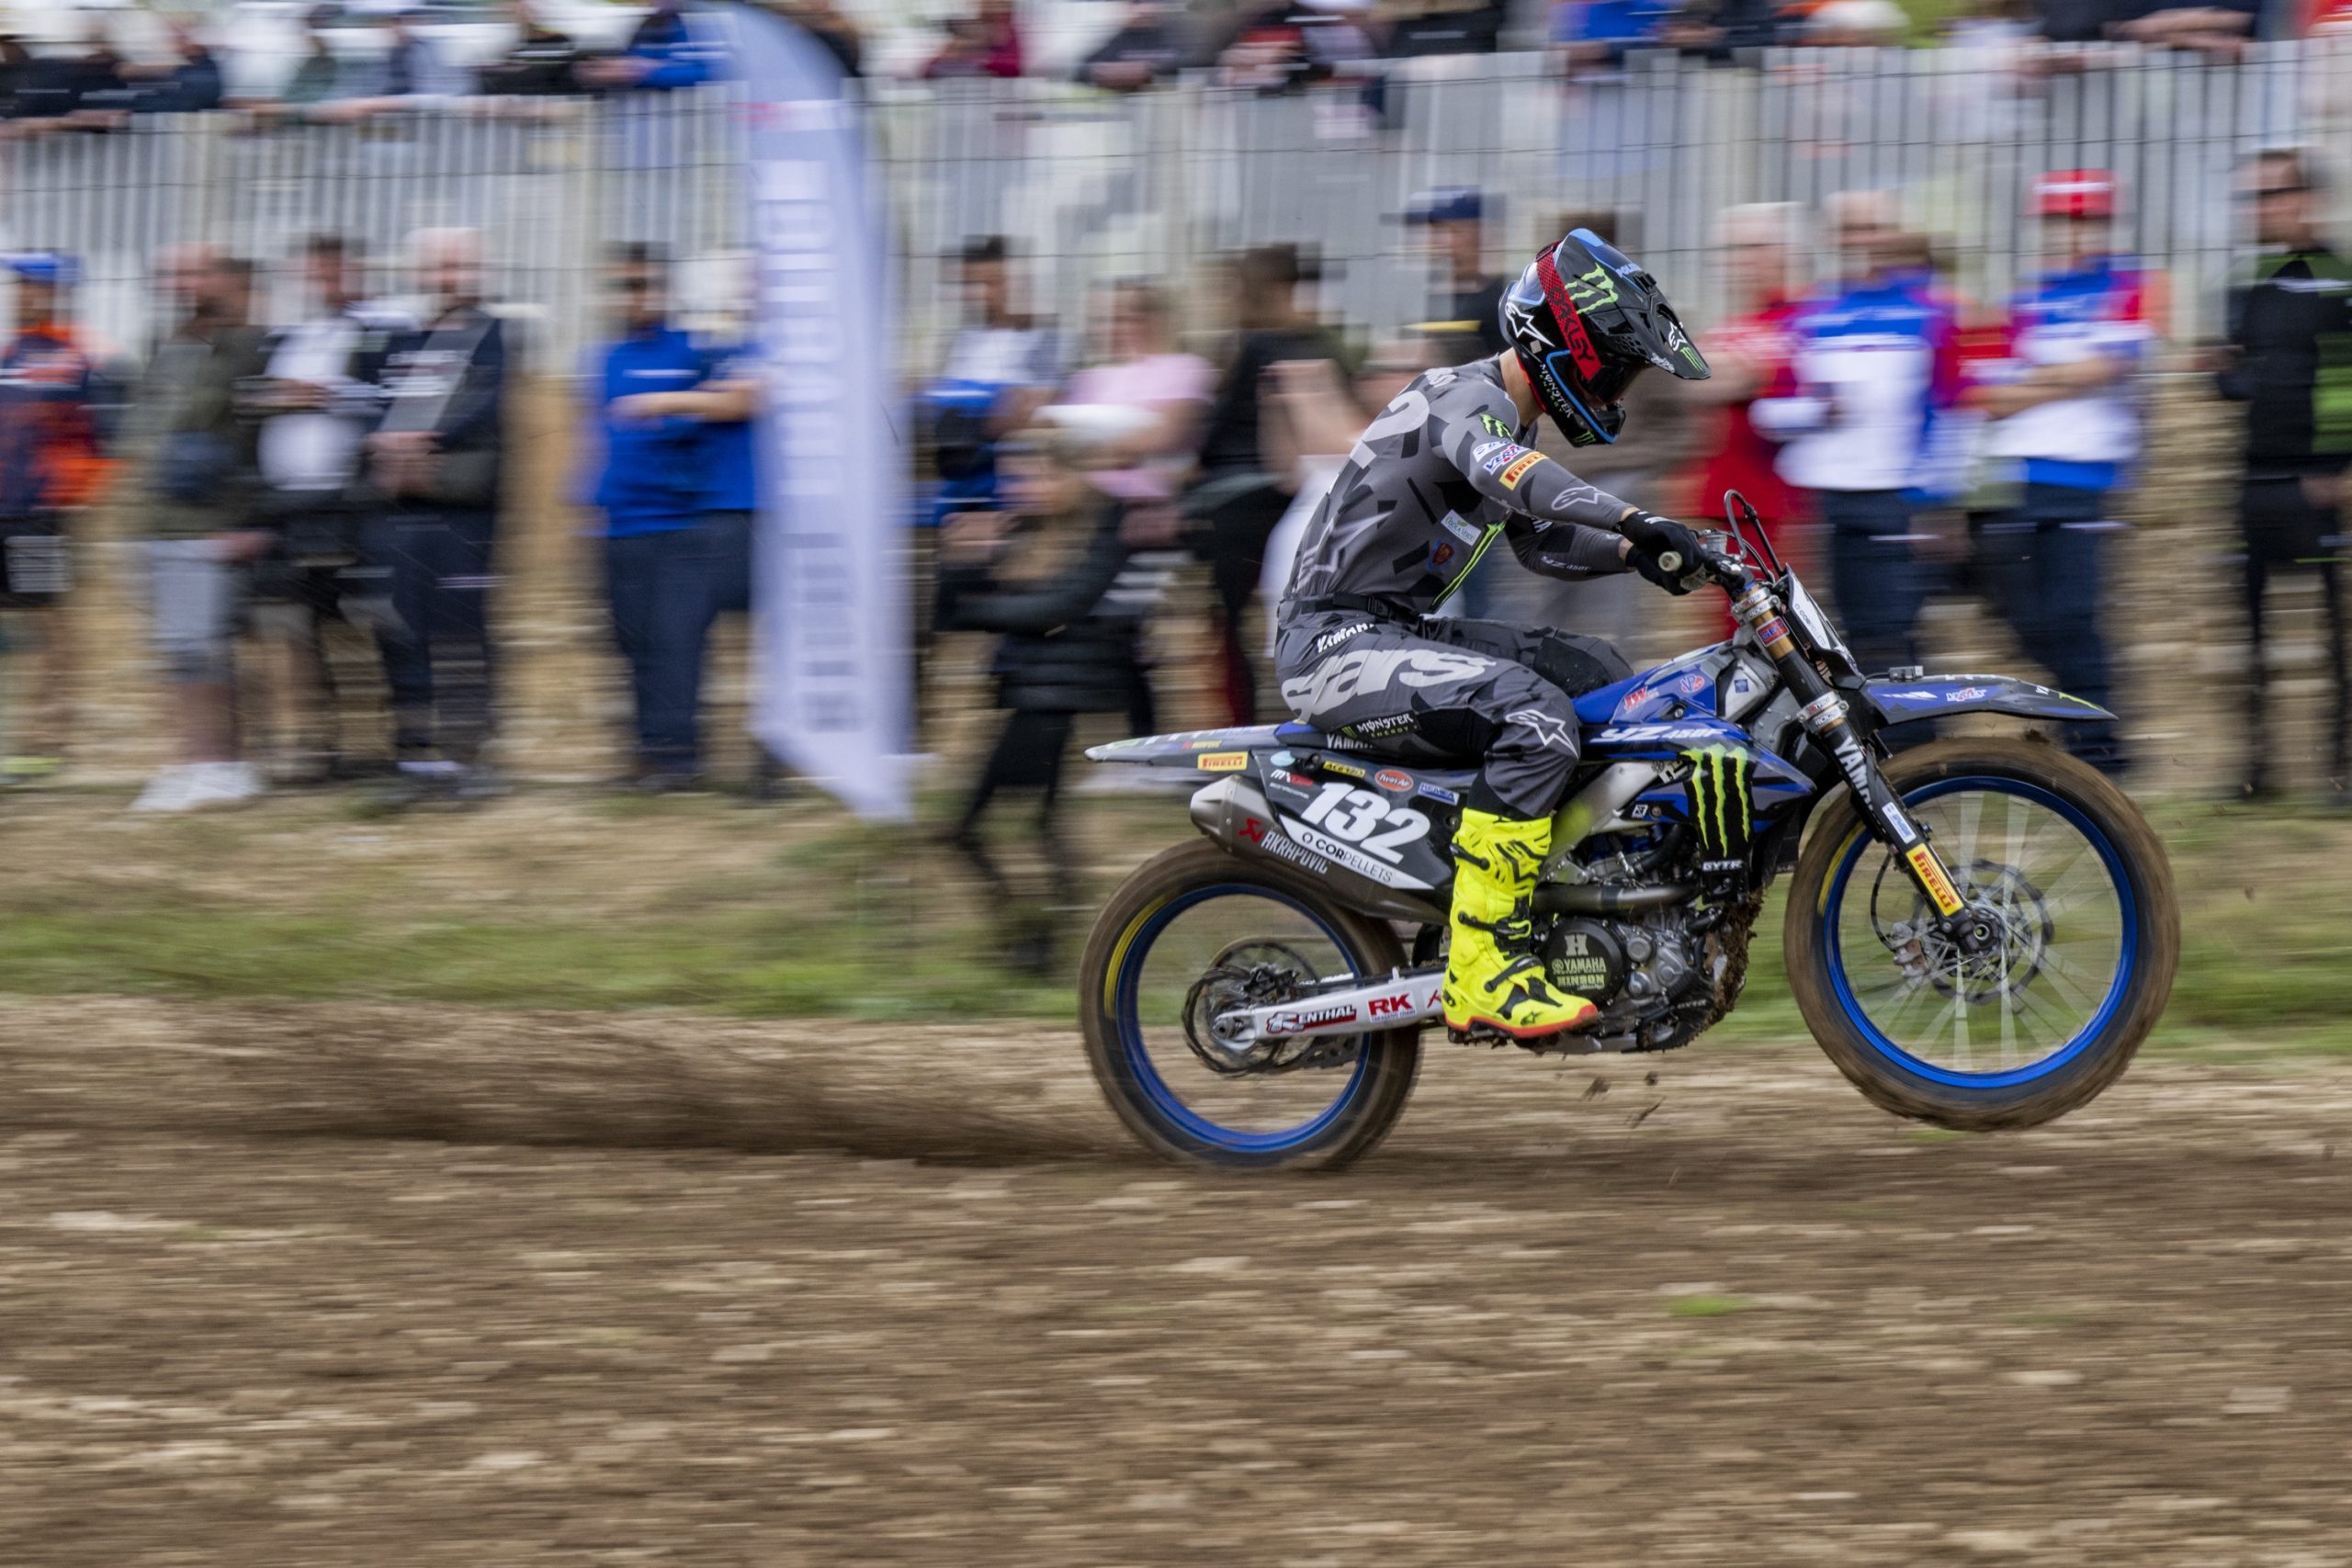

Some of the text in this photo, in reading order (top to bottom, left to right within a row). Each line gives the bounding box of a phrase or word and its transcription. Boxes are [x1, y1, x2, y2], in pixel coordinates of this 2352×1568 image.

[1548, 285, 1597, 363] OAKLEY
[1539, 363, 1575, 419] MONSTER
[1356, 713, 1414, 734] MONSTER
[1202, 756, 1243, 769] PIRELLI
[1300, 782, 1431, 864] 132
[1315, 838, 1394, 884] CORPELLETS
[1913, 850, 1957, 908] PIRELLI
[1564, 956, 1607, 975] YAMAHA
[1368, 992, 1414, 1016] RK
